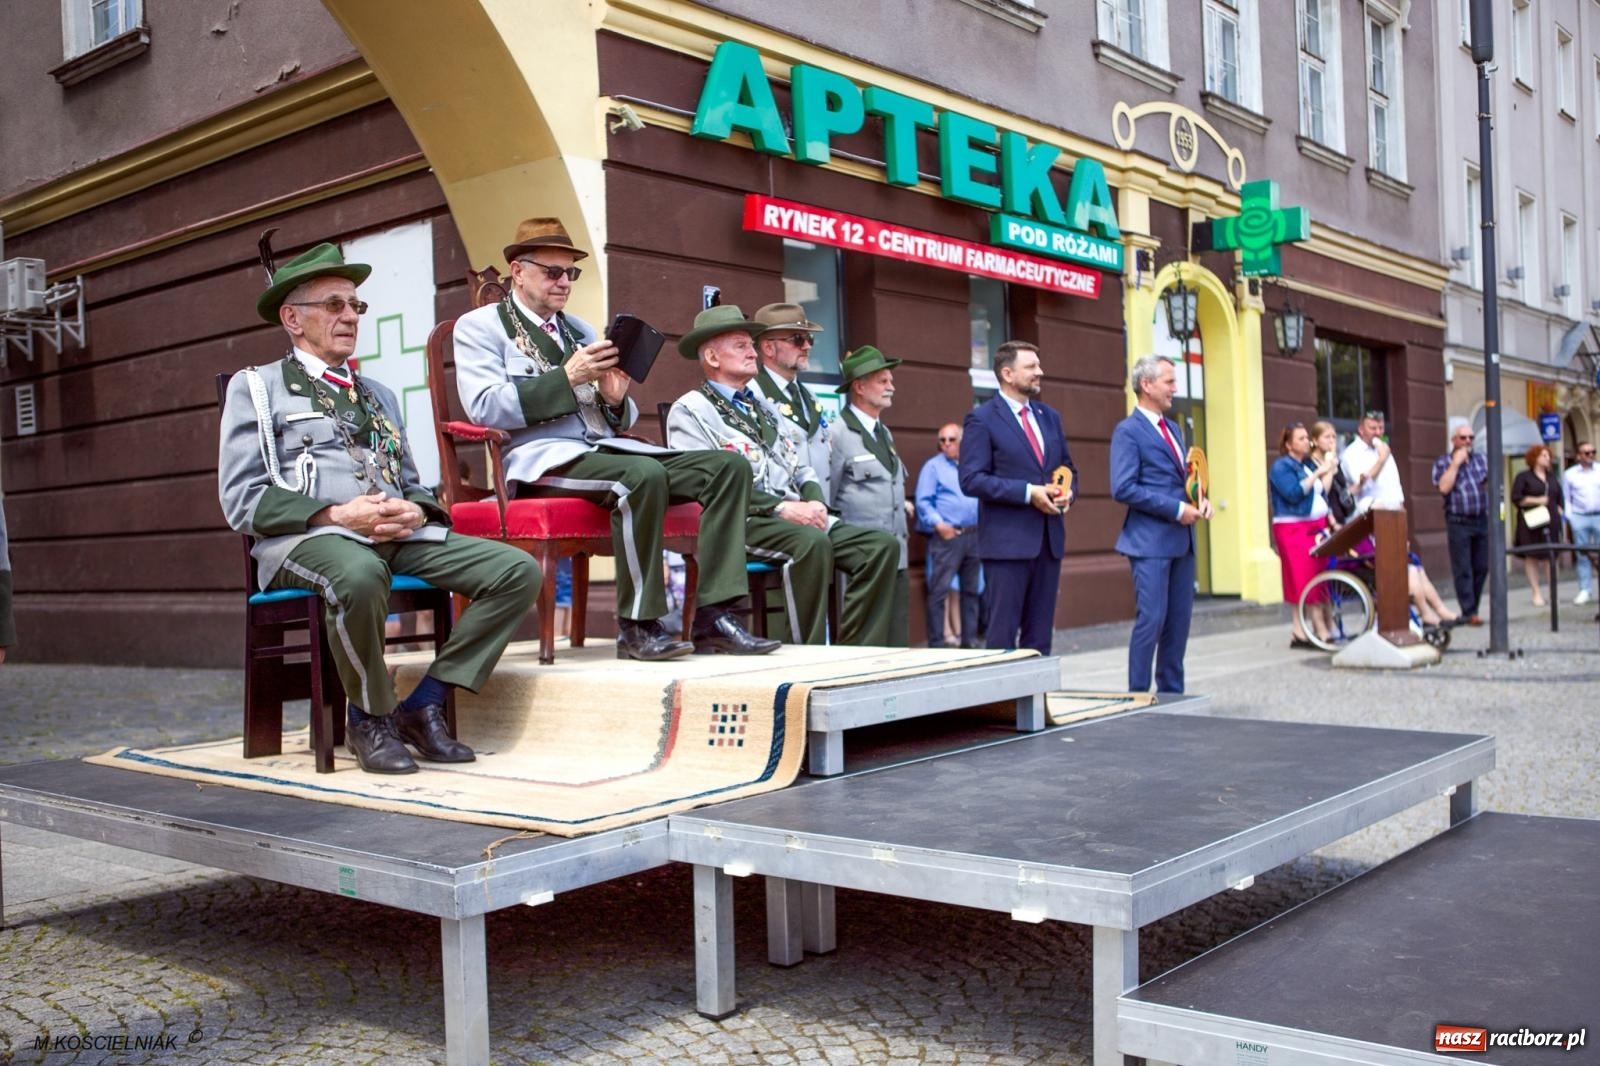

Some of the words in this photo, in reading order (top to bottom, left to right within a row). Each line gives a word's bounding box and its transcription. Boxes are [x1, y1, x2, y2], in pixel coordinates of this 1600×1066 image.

[690, 40, 1121, 240] APTEKA
[764, 204, 836, 240] RYNEK
[841, 221, 865, 246] 12
[878, 229, 963, 267] CENTRUM
[966, 248, 1096, 294] FARMACEUTYCZNE
[1008, 222, 1048, 247] POD
[1052, 233, 1119, 265] RÓŻAMI
[1236, 1041, 1268, 1053] HANDY
